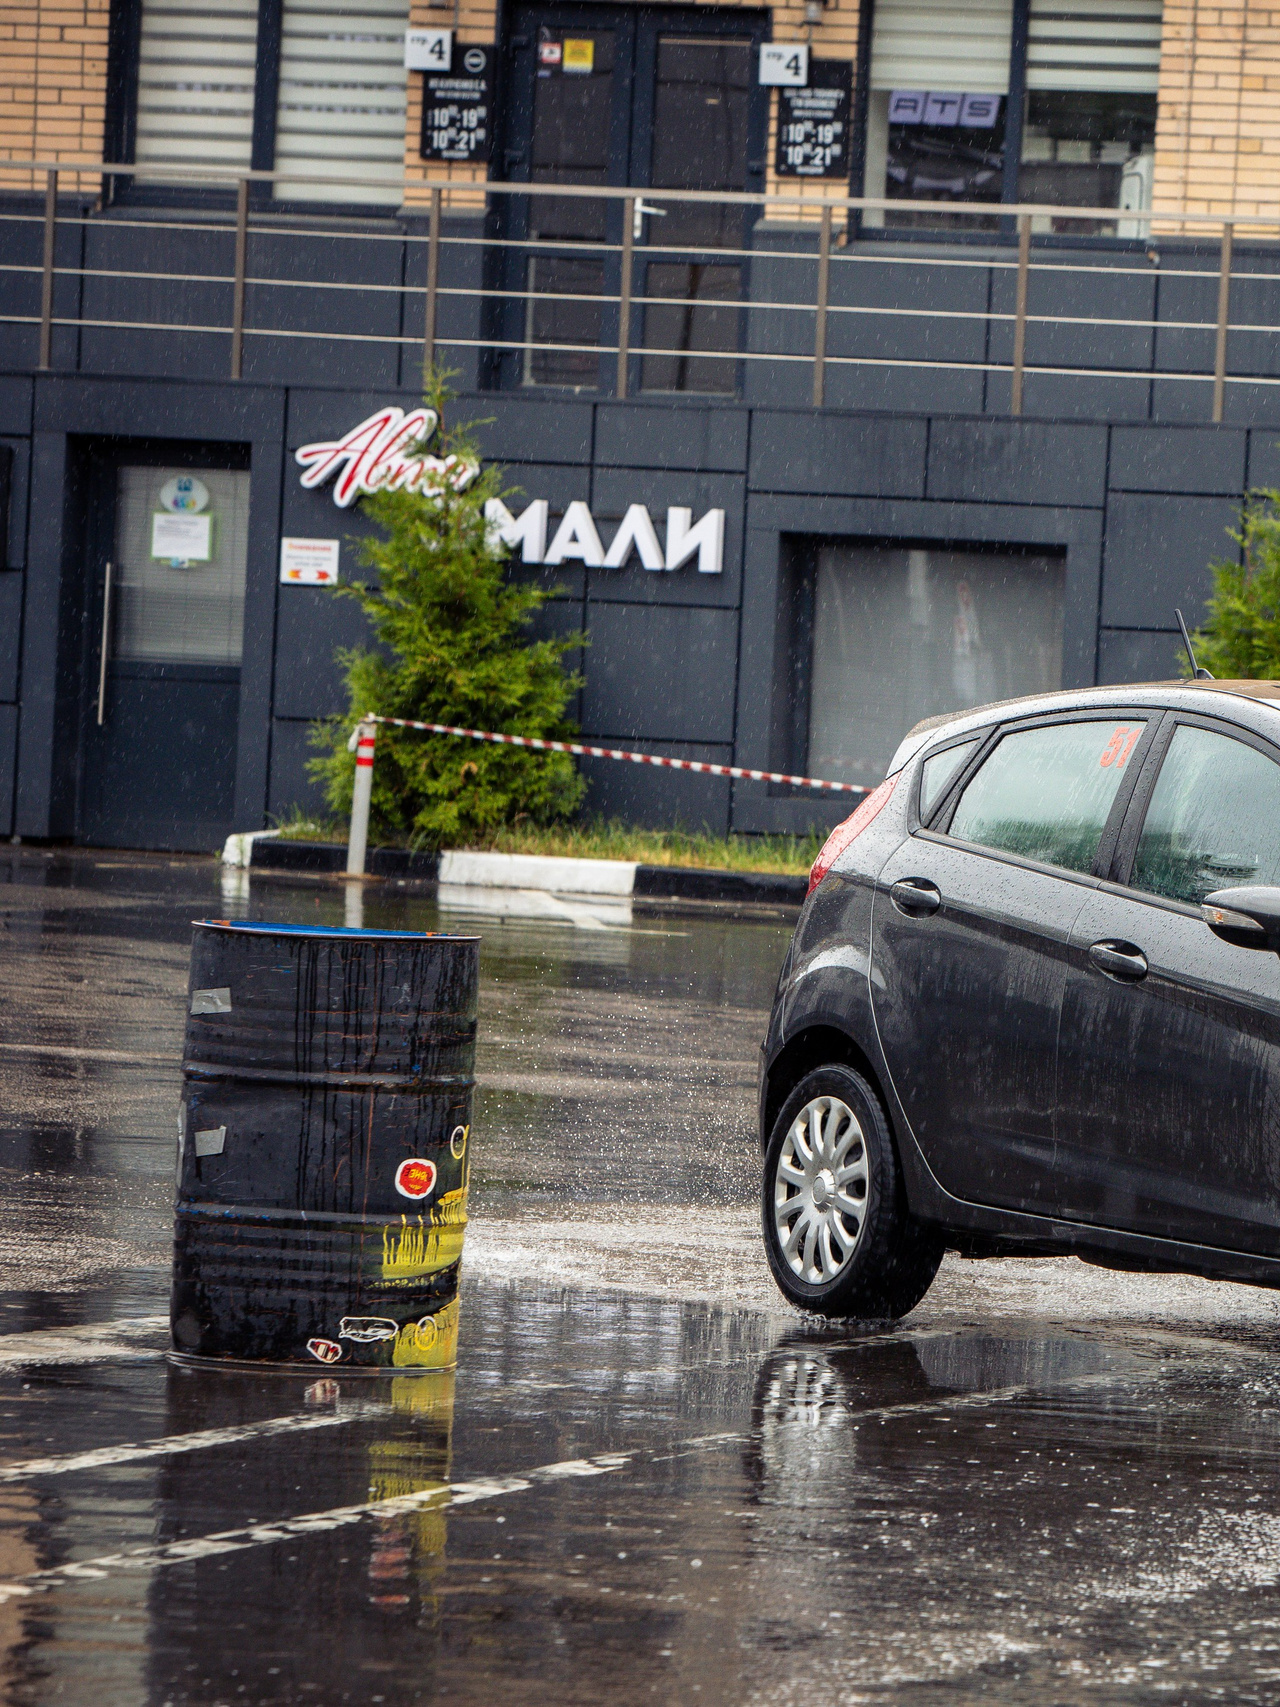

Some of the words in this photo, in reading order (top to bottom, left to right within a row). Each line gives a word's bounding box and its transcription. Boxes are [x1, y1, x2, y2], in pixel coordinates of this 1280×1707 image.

[429, 38, 446, 61] 4
[785, 53, 802, 77] 4
[893, 97, 993, 118] ATS
[436, 497, 725, 574] МАЛИ
[1100, 726, 1142, 768] 51
